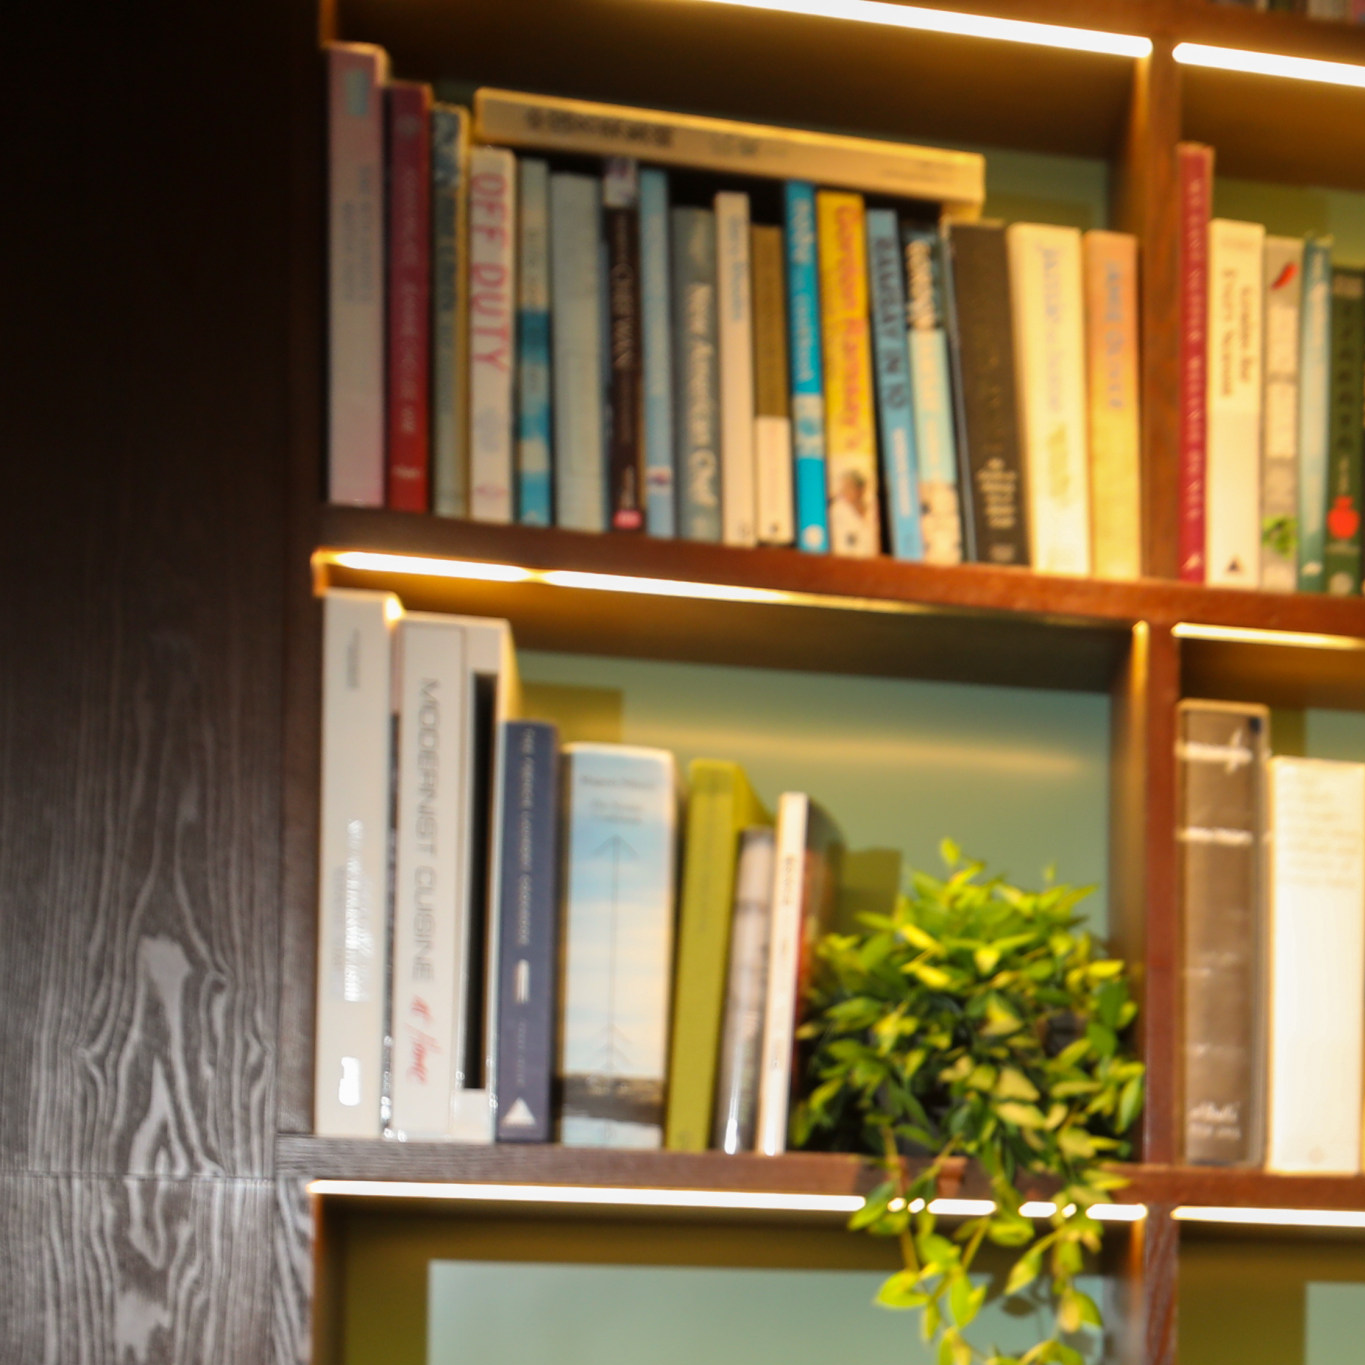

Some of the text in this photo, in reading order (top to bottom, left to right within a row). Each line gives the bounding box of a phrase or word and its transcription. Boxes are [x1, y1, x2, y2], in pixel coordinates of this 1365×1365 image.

[473, 172, 509, 371] OFF DUTY
[837, 206, 864, 310] Gordon
[873, 237, 901, 340] RAMSAY
[688, 282, 716, 507] New American Chef
[883, 348, 903, 375] IN
[414, 678, 440, 860] MODERNIST
[411, 864, 436, 984] CUISINE
